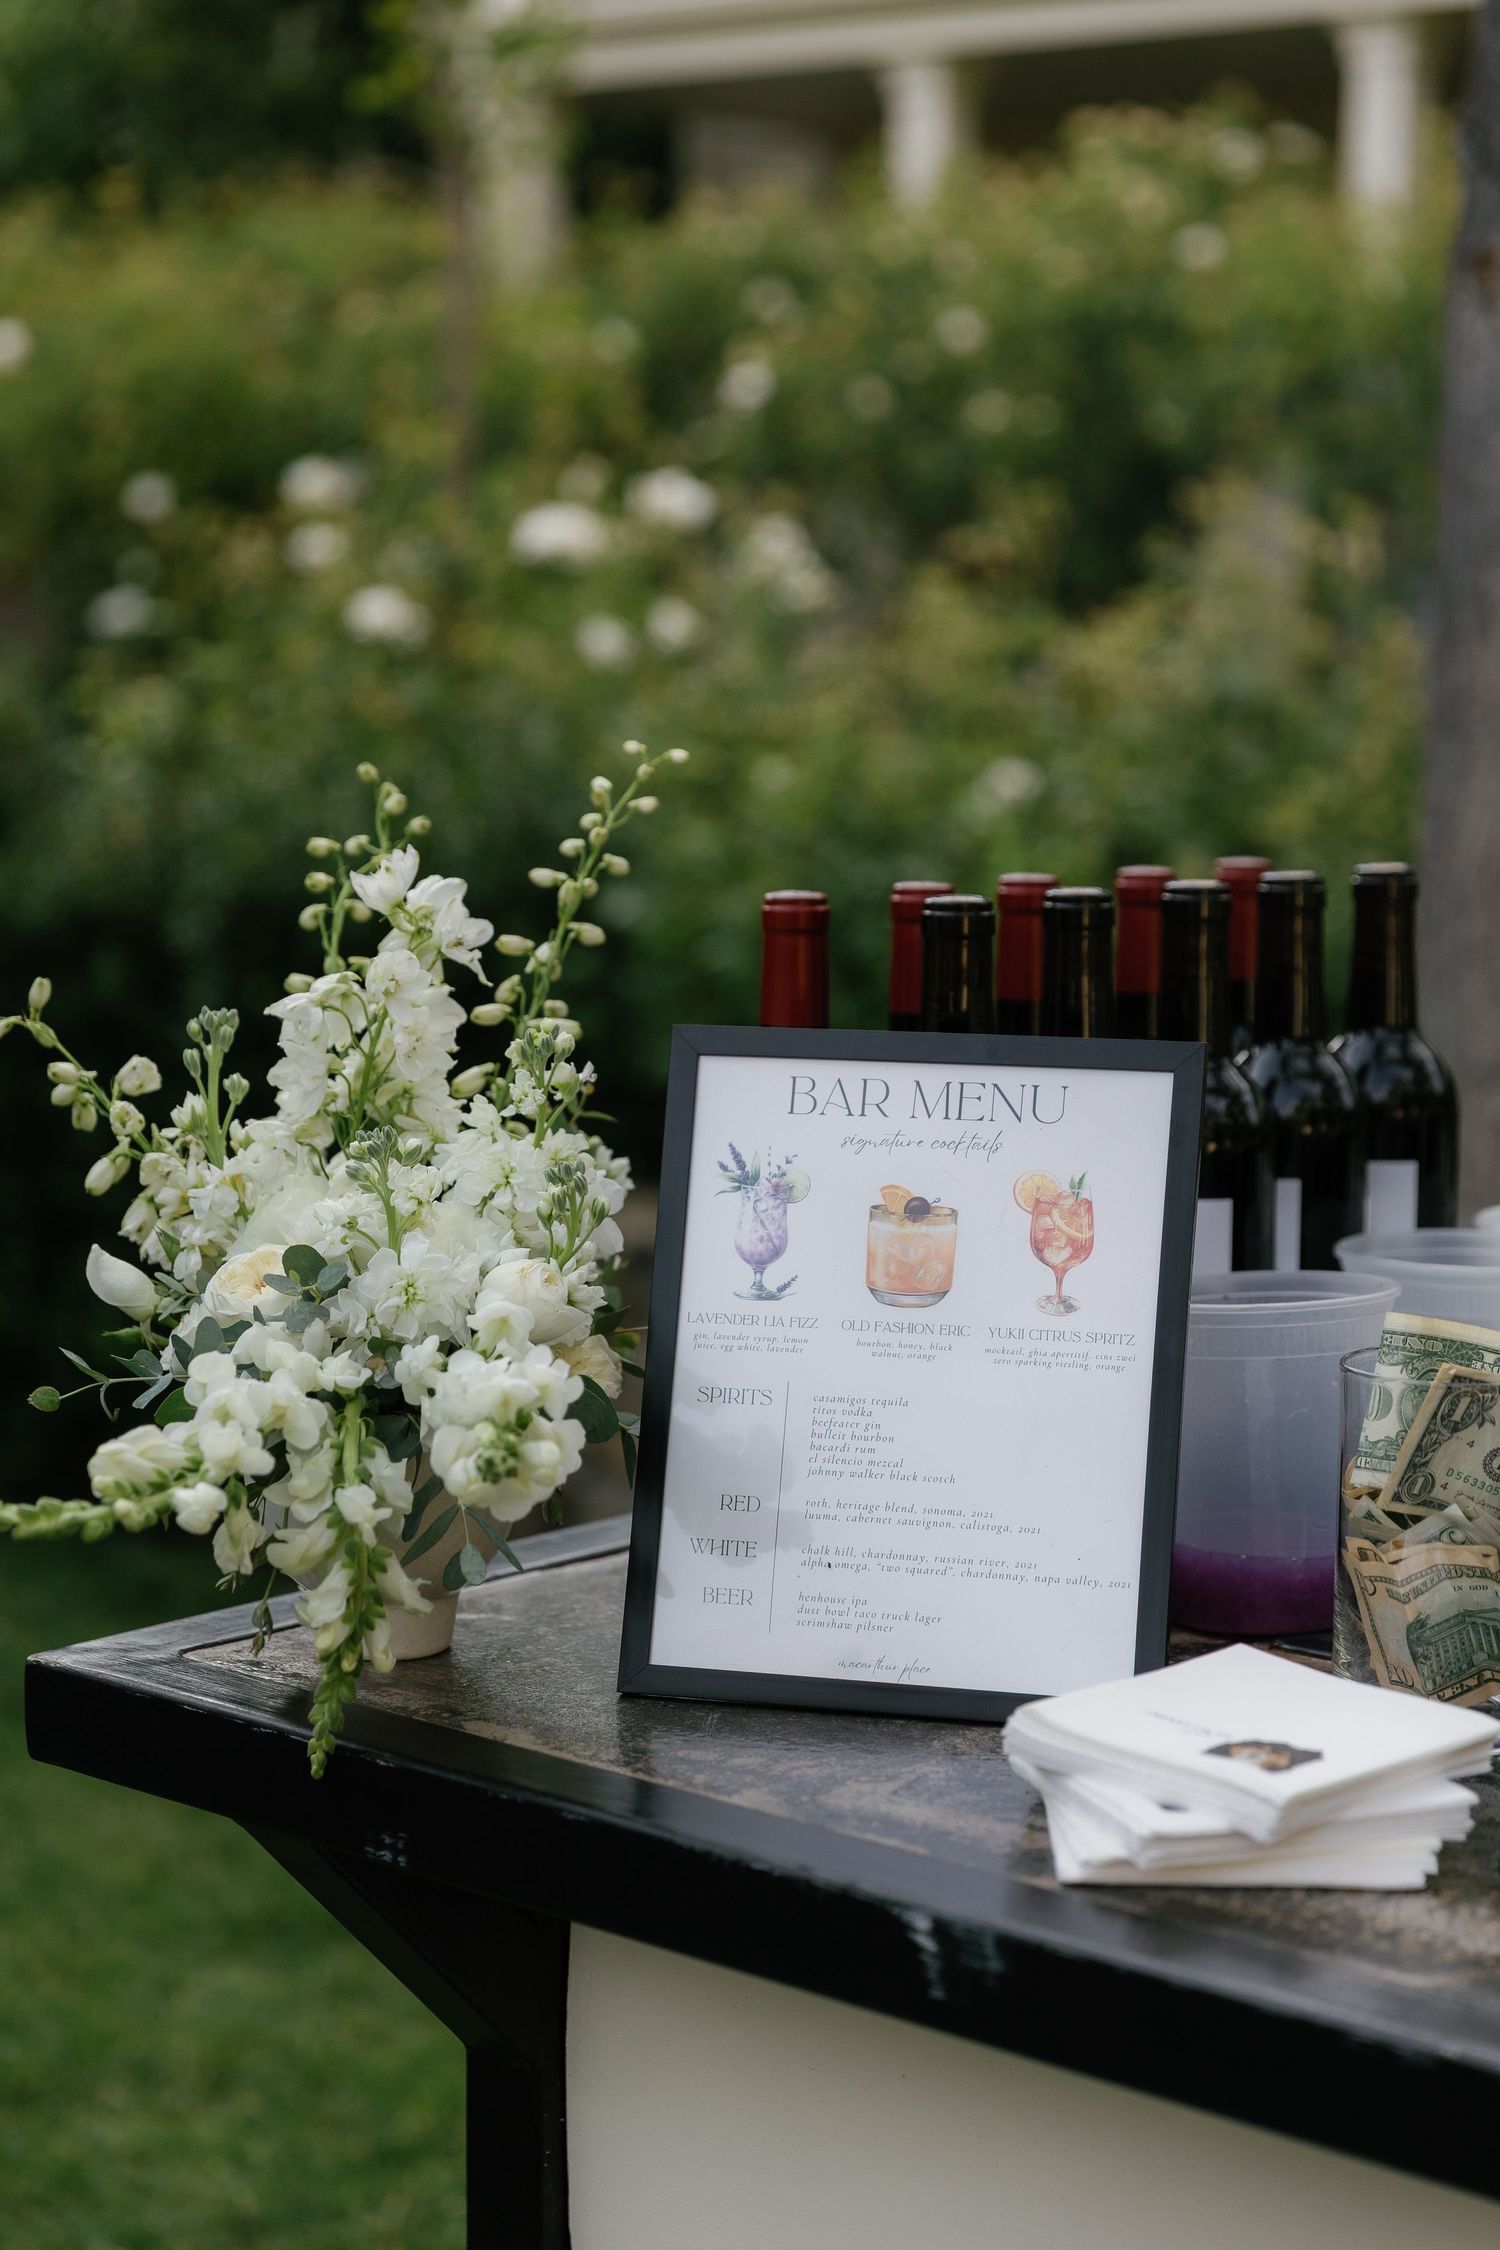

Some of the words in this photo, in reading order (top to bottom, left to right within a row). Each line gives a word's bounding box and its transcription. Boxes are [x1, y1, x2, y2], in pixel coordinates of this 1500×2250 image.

[787, 1075, 890, 1118] BAR
[909, 1080, 1070, 1125] MENU
[840, 1129, 925, 1155] signature
[930, 1130, 1004, 1163] cocktails
[687, 1311, 760, 1326] LAVENDER
[764, 1315, 785, 1327] LIA
[789, 1316, 819, 1329] FIZZ
[841, 1319, 870, 1332] OLD
[874, 1321, 935, 1335] FASHION
[939, 1324, 971, 1337] ERIC
[713, 1331, 750, 1342] lavender
[783, 1335, 809, 1344] lemon
[1029, 1328, 1081, 1343] CITRUS
[1085, 1331, 1136, 1346] SPRITZ
[720, 1344, 734, 1352] egg
[767, 1344, 804, 1354] lavender
[930, 1342, 953, 1352] black
[1028, 1348, 1047, 1358] ghia
[1095, 1353, 1113, 1361] eins
[1116, 1354, 1137, 1362] zwei
[907, 1353, 937, 1362] orange
[993, 1357, 1012, 1365] zero
[1015, 1357, 1052, 1369] sparking
[1095, 1364, 1126, 1373] orange
[696, 1386, 773, 1407] SPIRITS
[813, 1395, 867, 1407] casamigos
[871, 1397, 909, 1408] tequila
[812, 1405, 837, 1415] titos
[841, 1406, 873, 1417] vodka
[811, 1417, 861, 1431] beefeater
[864, 1421, 881, 1432] gin
[810, 1428, 845, 1440] bulleit
[851, 1430, 894, 1443] bourbon
[809, 1441, 850, 1453] bacardi
[855, 1446, 876, 1454] rum
[808, 1453, 818, 1464] el
[822, 1454, 863, 1466] silencio
[867, 1458, 904, 1469] mezcal
[806, 1466, 844, 1480] johnny
[849, 1468, 886, 1481] walker
[889, 1470, 918, 1482] black
[922, 1473, 955, 1484] scotch
[720, 1493, 761, 1513] RED
[836, 1498, 880, 1514] heritage
[885, 1502, 917, 1514] blend,
[922, 1508, 966, 1518] sonoma,
[971, 1510, 994, 1519] 2021
[804, 1509, 841, 1522] luuma,
[846, 1513, 892, 1525] cabernet
[896, 1517, 955, 1530] sauvignon,
[960, 1520, 1013, 1535] calistoga,
[1018, 1526, 1041, 1535] 2021
[689, 1537, 757, 1558] WHITE
[802, 1544, 831, 1556] chalk
[861, 1548, 929, 1565] chardonnay,
[934, 1555, 974, 1565] russian
[979, 1557, 1009, 1569] river,
[1014, 1561, 1038, 1569] 2021
[800, 1557, 830, 1570] alpha
[834, 1561, 871, 1573] omega,
[960, 1568, 1029, 1584] chardonnay,
[1034, 1575, 1060, 1586] napa
[1065, 1575, 1103, 1590] valley,
[1108, 1581, 1131, 1589] 2021
[702, 1586, 753, 1607] BEER
[1469, 1584, 1489, 1592] GOD
[798, 1591, 847, 1605] henhouse
[851, 1595, 868, 1608] ipa
[797, 1604, 820, 1615] dust
[825, 1605, 850, 1617] bowl
[854, 1610, 877, 1620] taco
[881, 1610, 910, 1622] truck
[914, 1612, 943, 1626] lager
[796, 1618, 852, 1630] scrimshaw
[856, 1620, 895, 1633] pilsner
[897, 1658, 931, 1684] place
